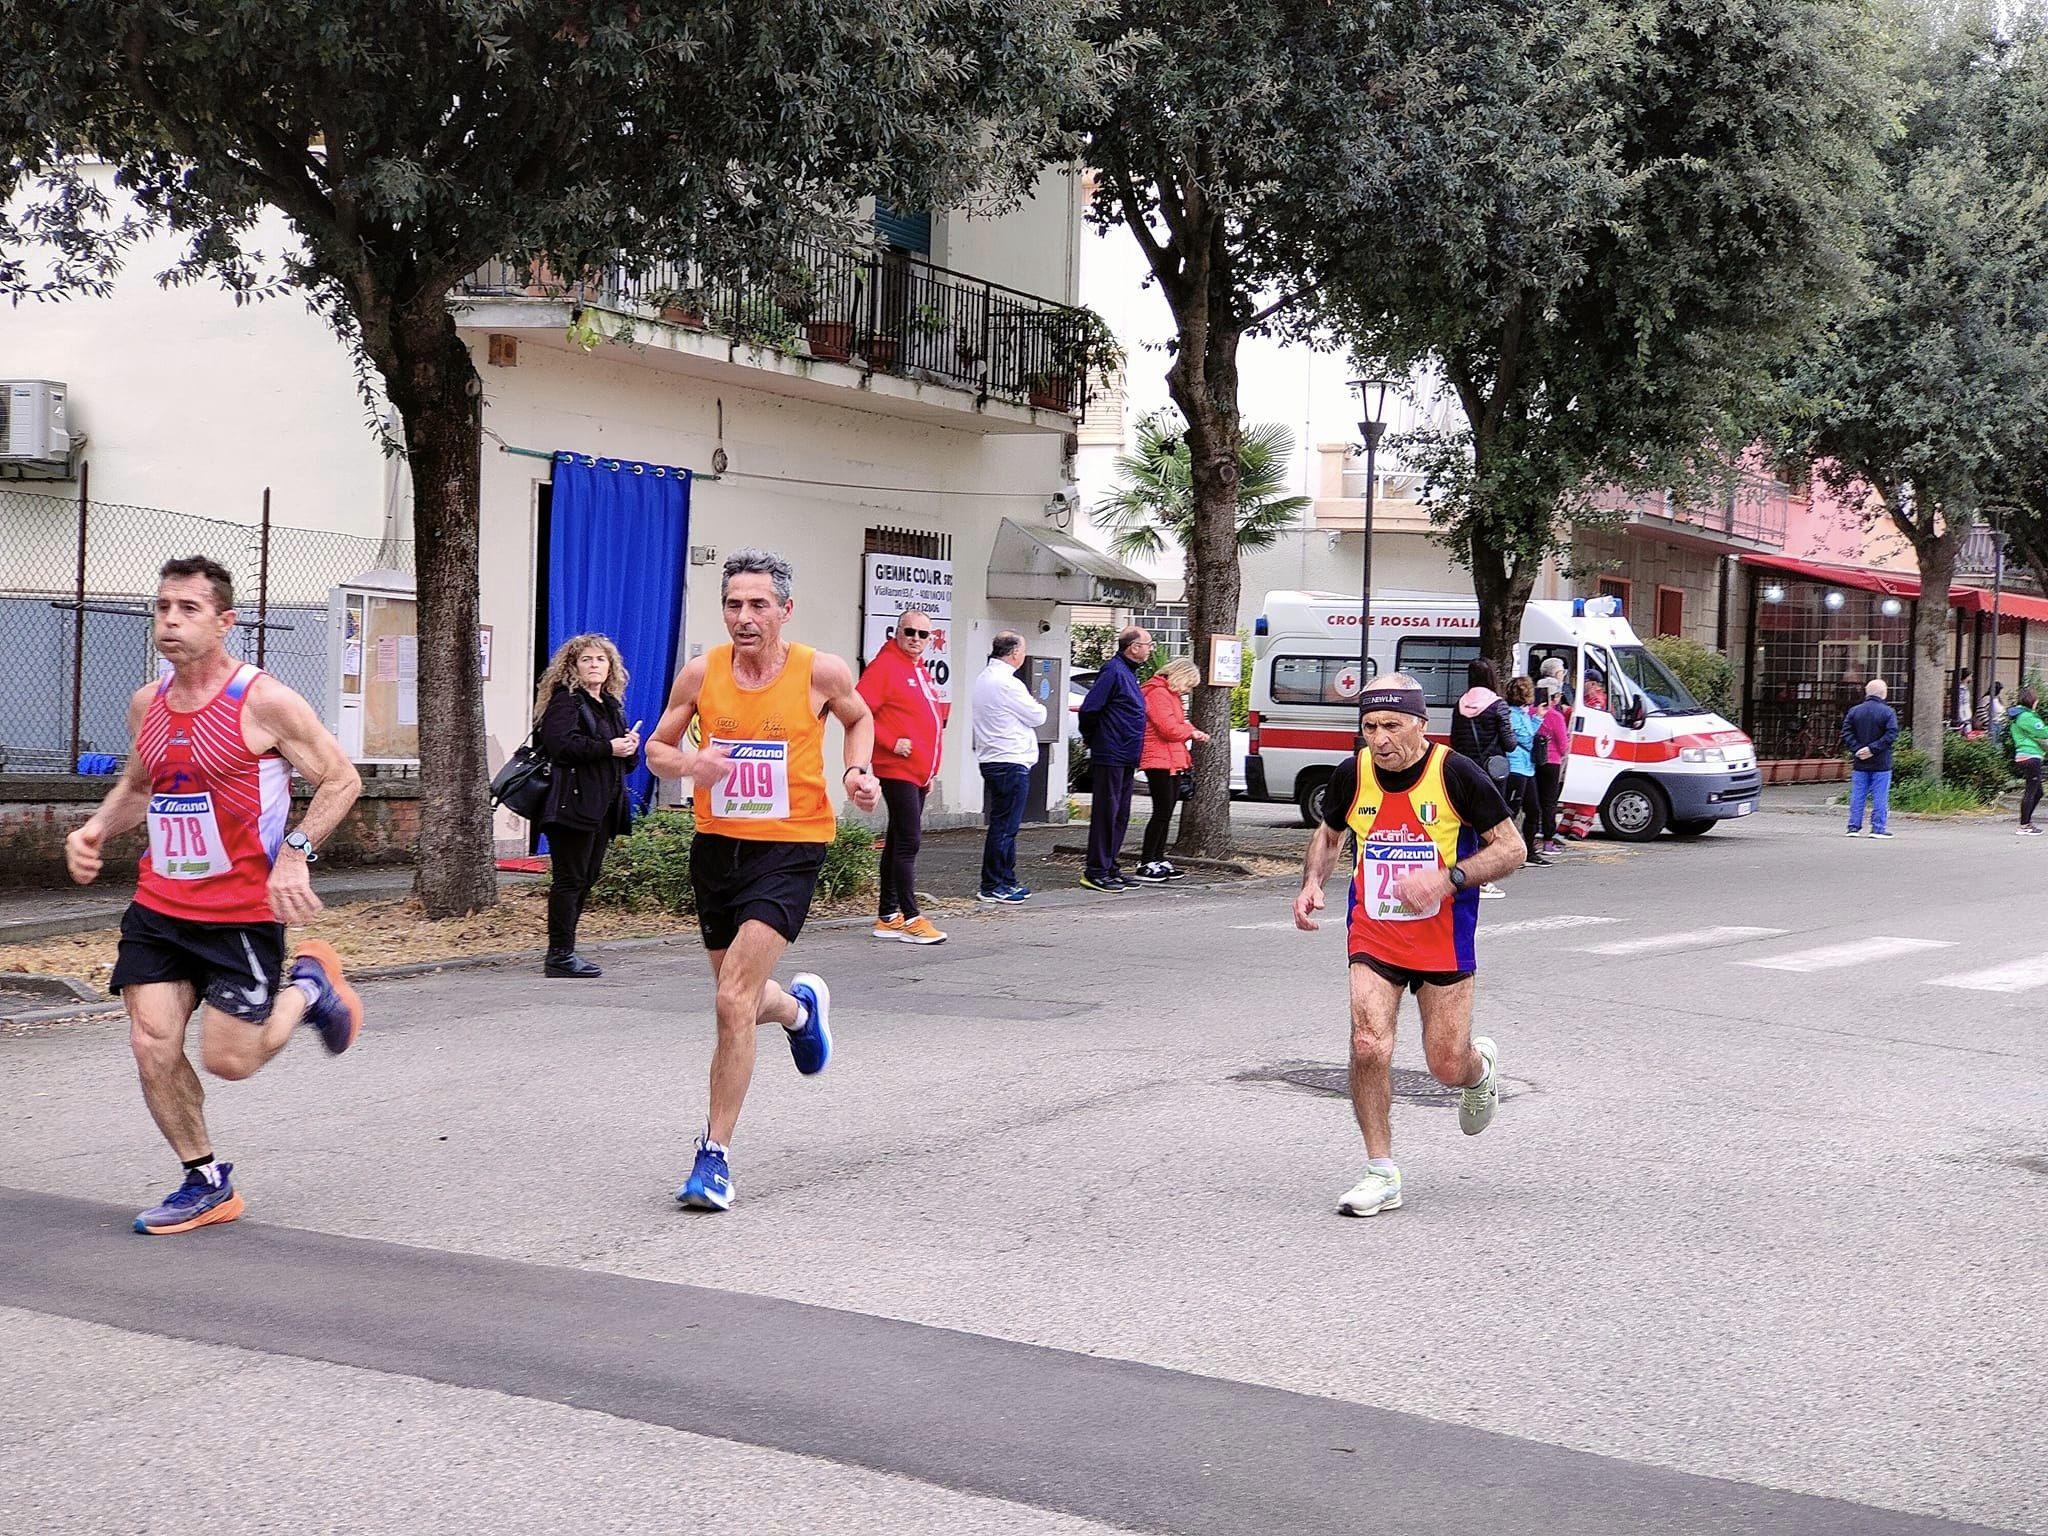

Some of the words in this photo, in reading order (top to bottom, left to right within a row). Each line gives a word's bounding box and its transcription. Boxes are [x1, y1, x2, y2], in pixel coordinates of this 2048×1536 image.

[1327, 615, 1375, 626] CROCE
[1381, 616, 1430, 627] ROSSA
[724, 762, 773, 797] 209
[160, 816, 207, 857] 278
[1376, 863, 1423, 899] 25
